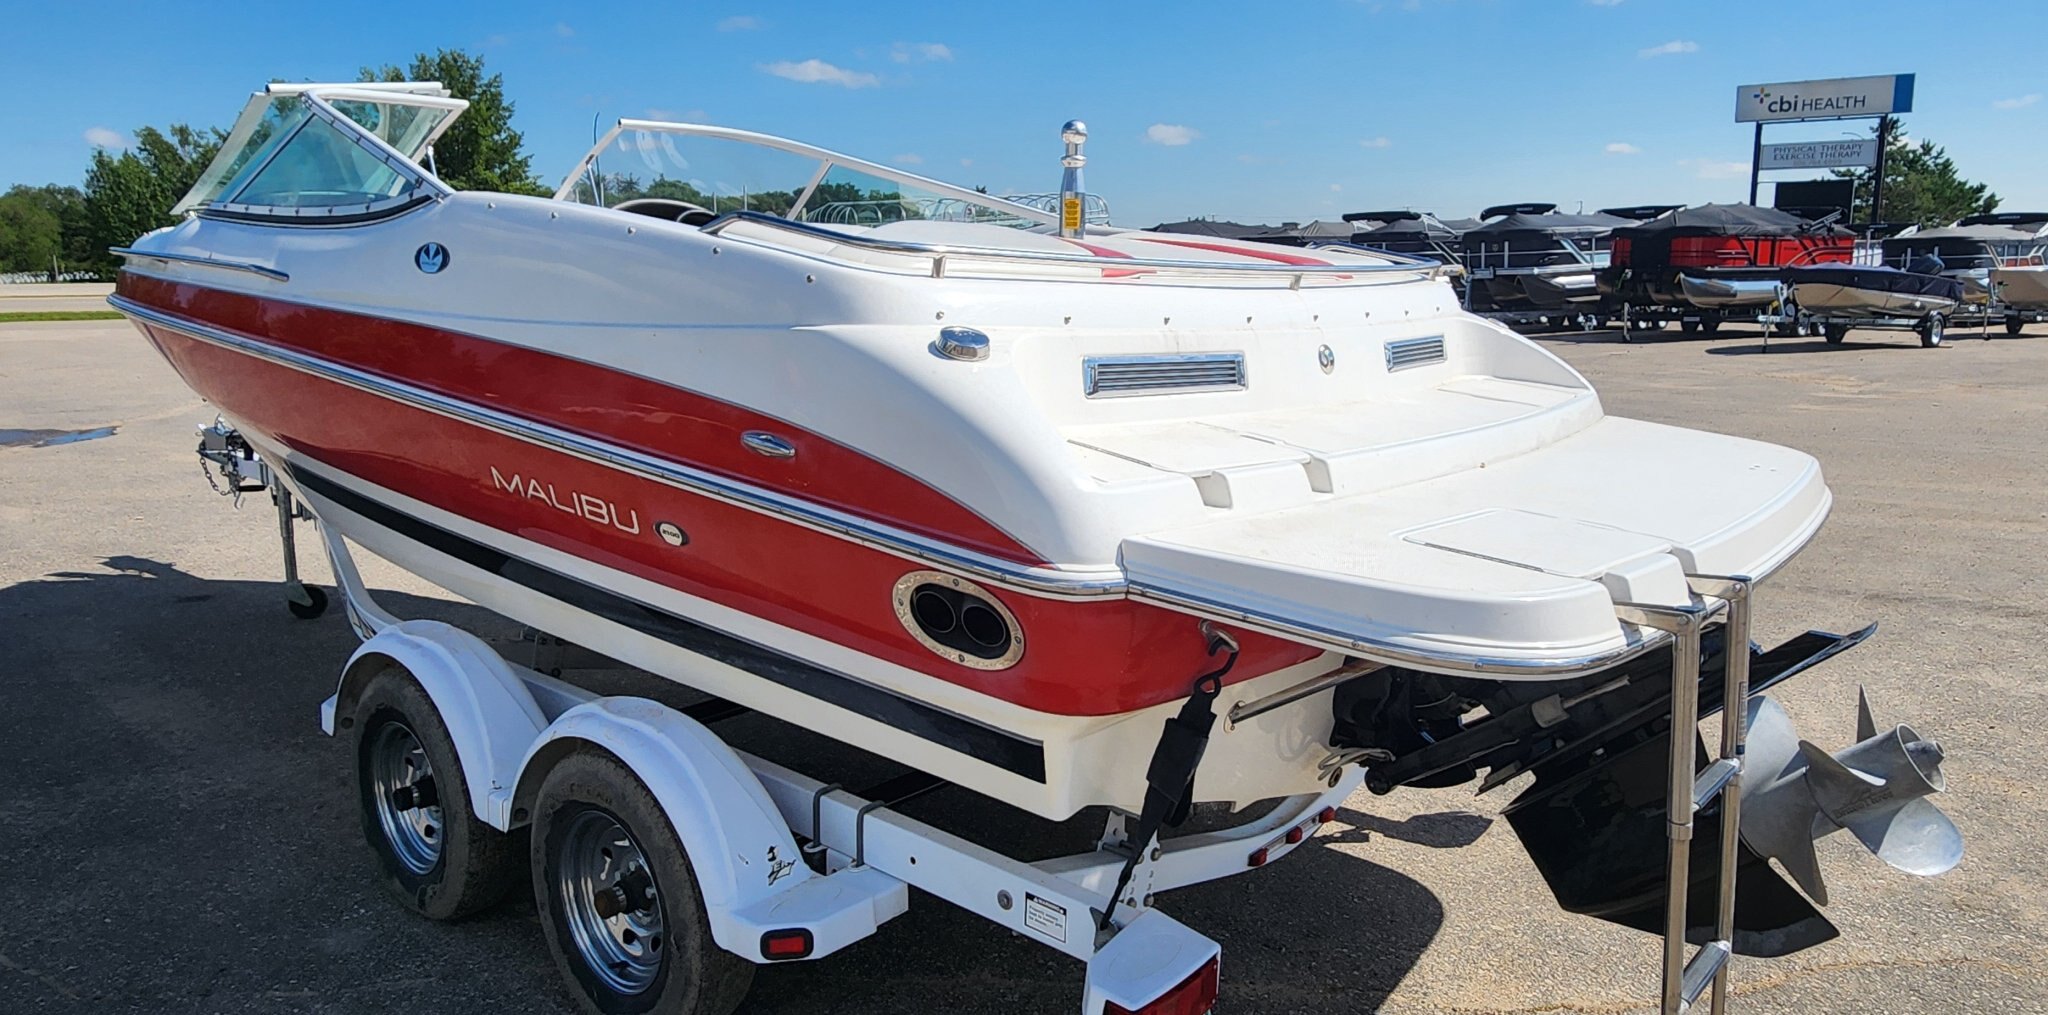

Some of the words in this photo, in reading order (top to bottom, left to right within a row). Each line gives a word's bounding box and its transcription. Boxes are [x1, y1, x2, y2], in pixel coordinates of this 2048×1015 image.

[1768, 94, 1799, 113] cbi
[1801, 95, 1866, 112] HEALTH
[1773, 145, 1817, 154] PHYSICAL
[1821, 143, 1863, 152] THERAPY
[1773, 152, 1816, 161] EXERCISE
[1820, 150, 1862, 159] THERAPY
[490, 465, 640, 535] MALIBU
